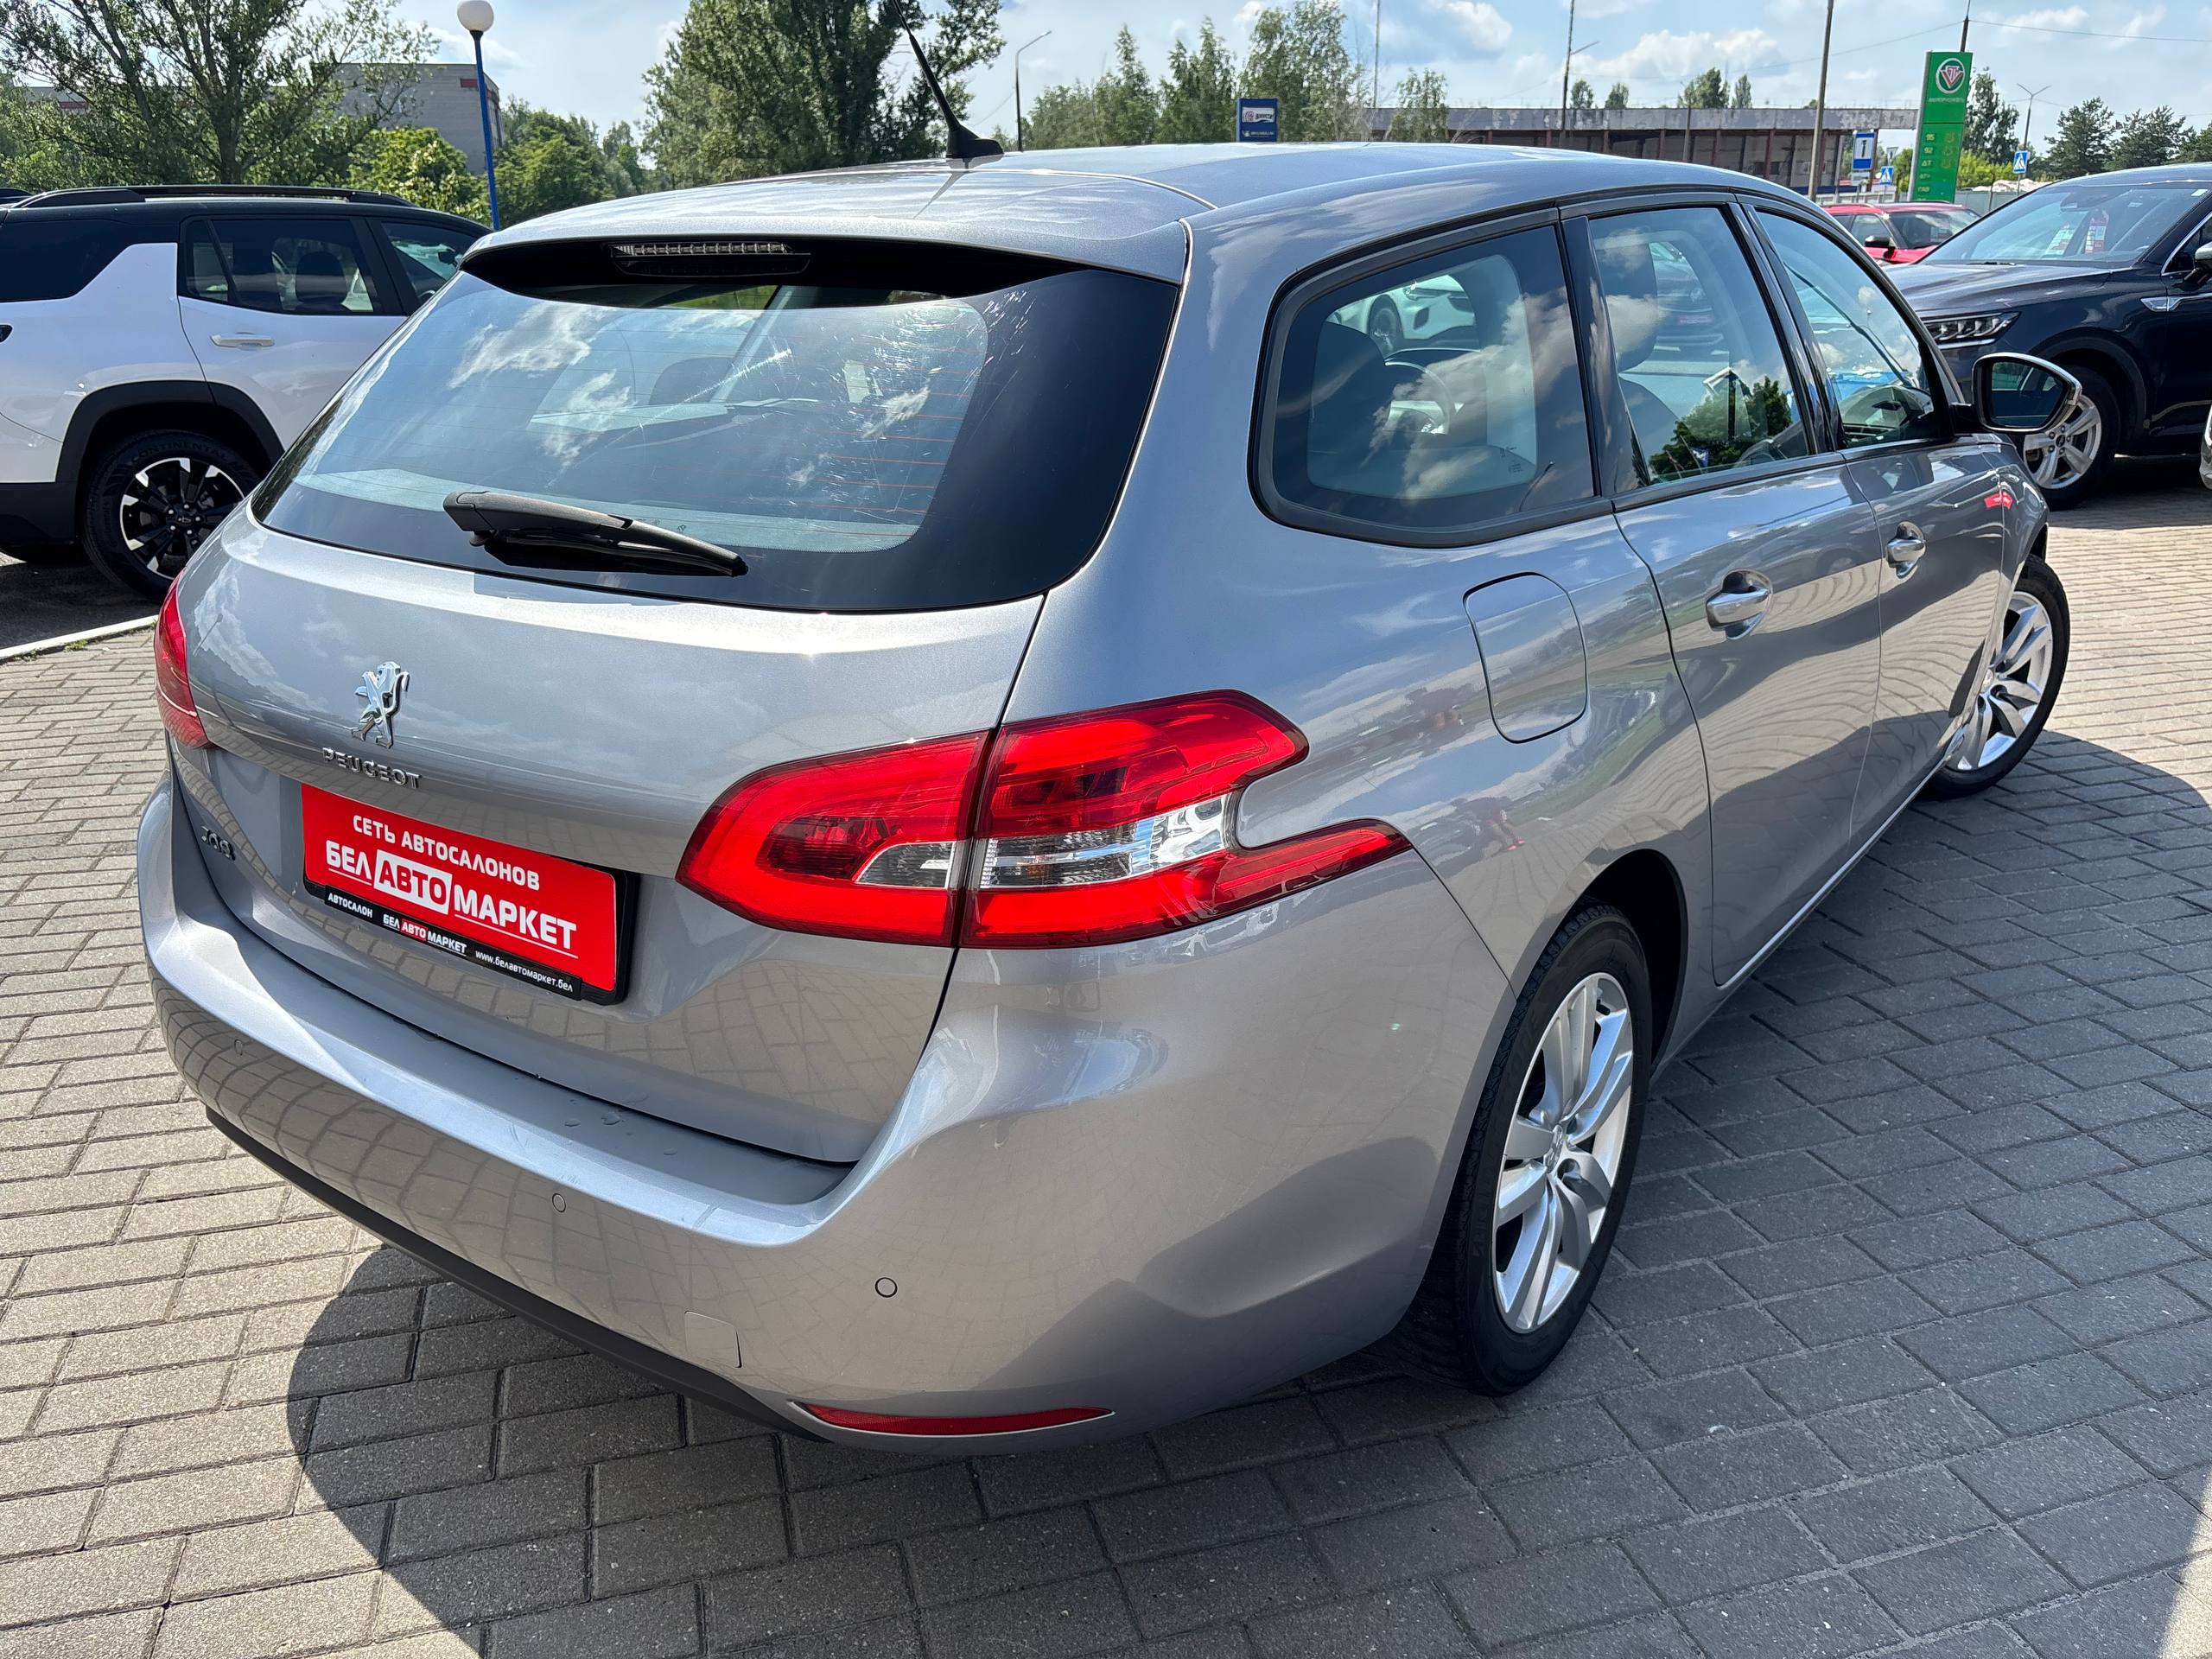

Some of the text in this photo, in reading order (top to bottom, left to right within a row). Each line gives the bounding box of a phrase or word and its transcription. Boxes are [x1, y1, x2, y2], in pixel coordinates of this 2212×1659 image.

[322, 747, 422, 789] PEUGEOT
[353, 815, 540, 891] СЕТЬ АВТОСАЛОНОВ
[327, 893, 373, 918] АВТОСАЛОН
[475, 950, 574, 993] www.белавтомаркет.бел
